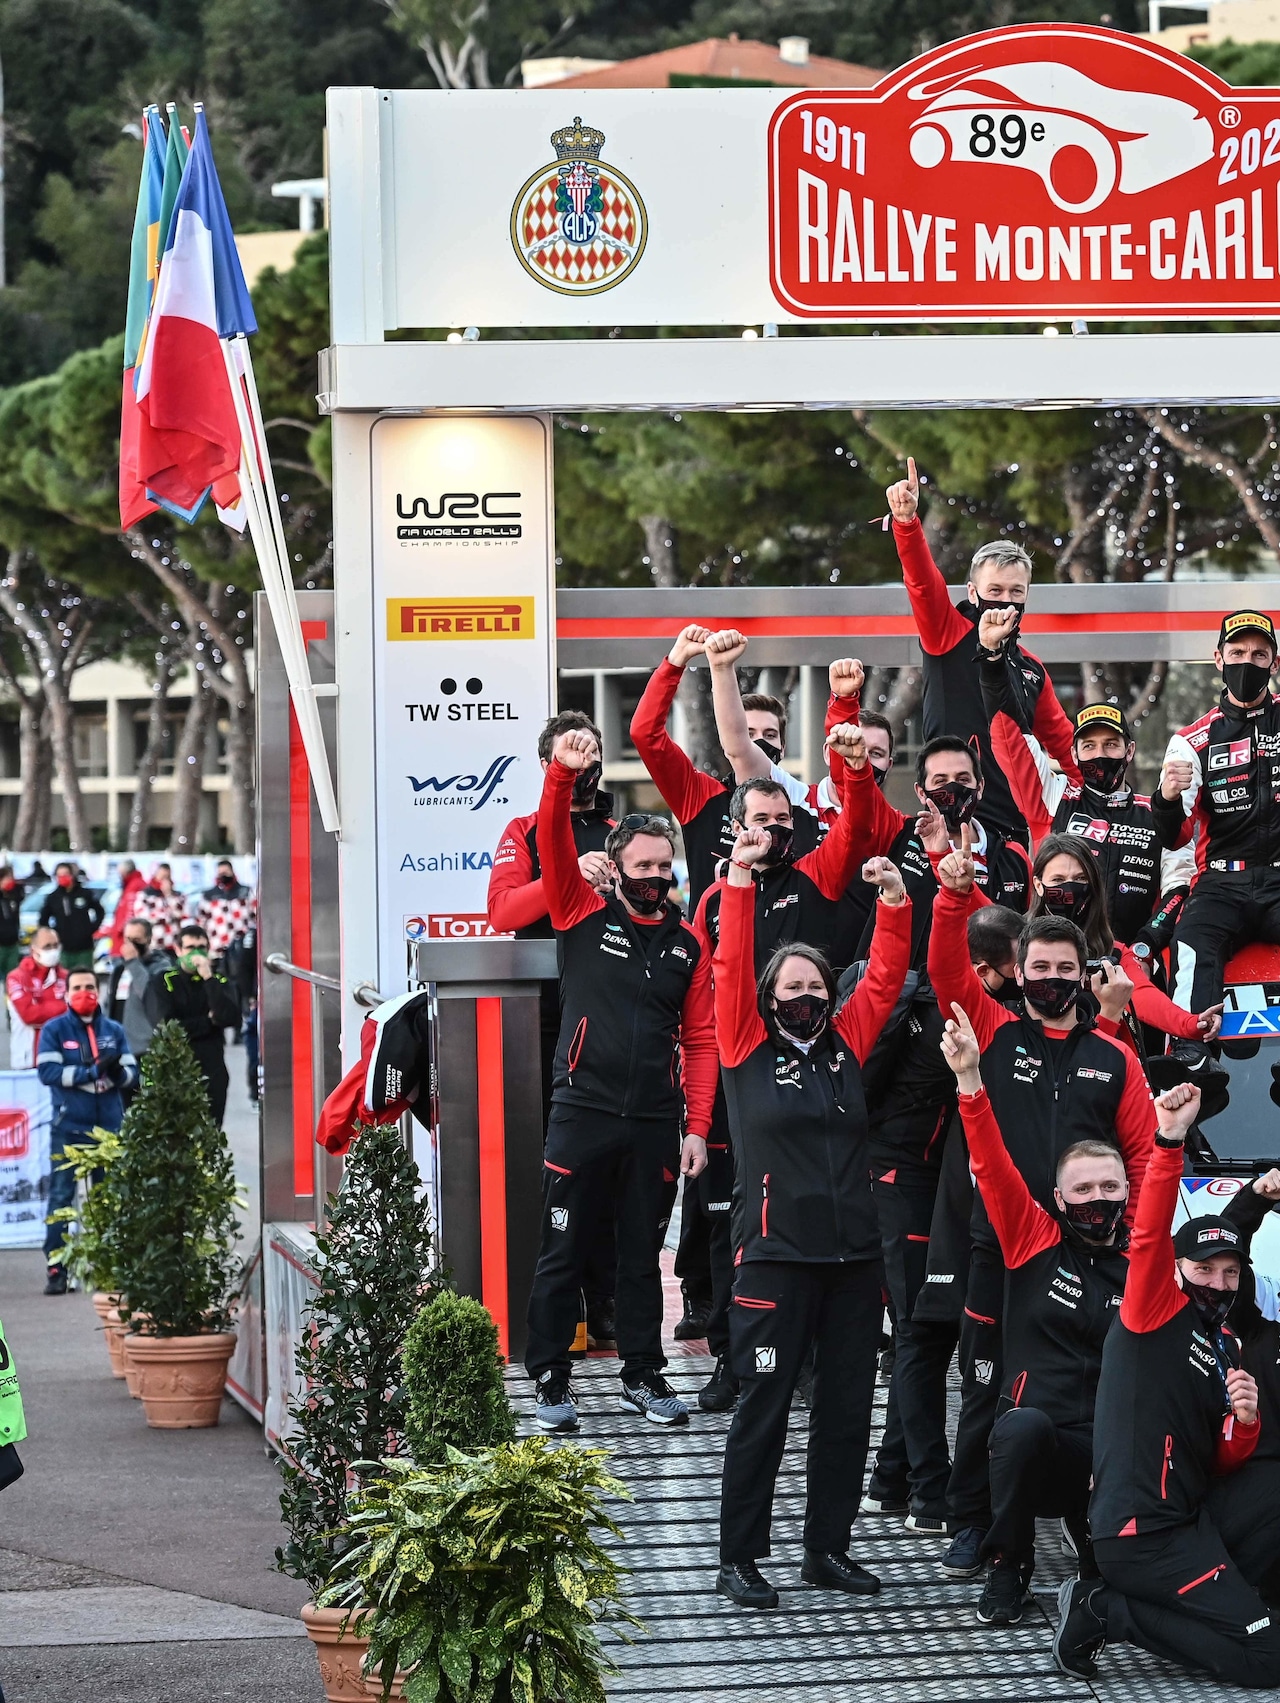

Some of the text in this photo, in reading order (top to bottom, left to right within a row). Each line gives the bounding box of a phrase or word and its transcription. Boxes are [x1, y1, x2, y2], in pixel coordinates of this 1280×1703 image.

[799, 109, 866, 177] 1911
[968, 113, 1046, 159] 89e
[798, 167, 957, 284] RALLYE
[396, 492, 522, 519] WRC
[399, 527, 520, 537] FIA WORLD RALLY
[401, 604, 521, 633] PIRELLI
[1228, 615, 1269, 629] PIRELLI
[405, 702, 519, 722] TW STEEL
[1079, 708, 1121, 723] PIRELLI
[1190, 732, 1209, 747] OMP
[1210, 749, 1250, 768] GR
[1227, 773, 1249, 786] MORI
[1231, 788, 1247, 797] CCI
[413, 797, 474, 806] LUBRICANTS
[720, 825, 738, 838] DEN
[1109, 830, 1151, 842] GAZOO
[1111, 822, 1157, 836] TOYOTA
[1107, 837, 1150, 850] Racing
[400, 851, 493, 872] AsahiKA
[1122, 854, 1154, 867] DENSO
[1118, 868, 1151, 881] Panasonic
[1129, 886, 1148, 894] HIPPO
[599, 943, 629, 959] Panasonic
[1014, 1057, 1039, 1079] DEO
[1217, 1182, 1233, 1191] E
[926, 1274, 955, 1284] YOKO
[1051, 1277, 1083, 1299] DENSO
[1047, 1290, 1078, 1310] Panasonic
[1189, 1342, 1217, 1366] DENSO
[1246, 1616, 1271, 1636] YOKO
